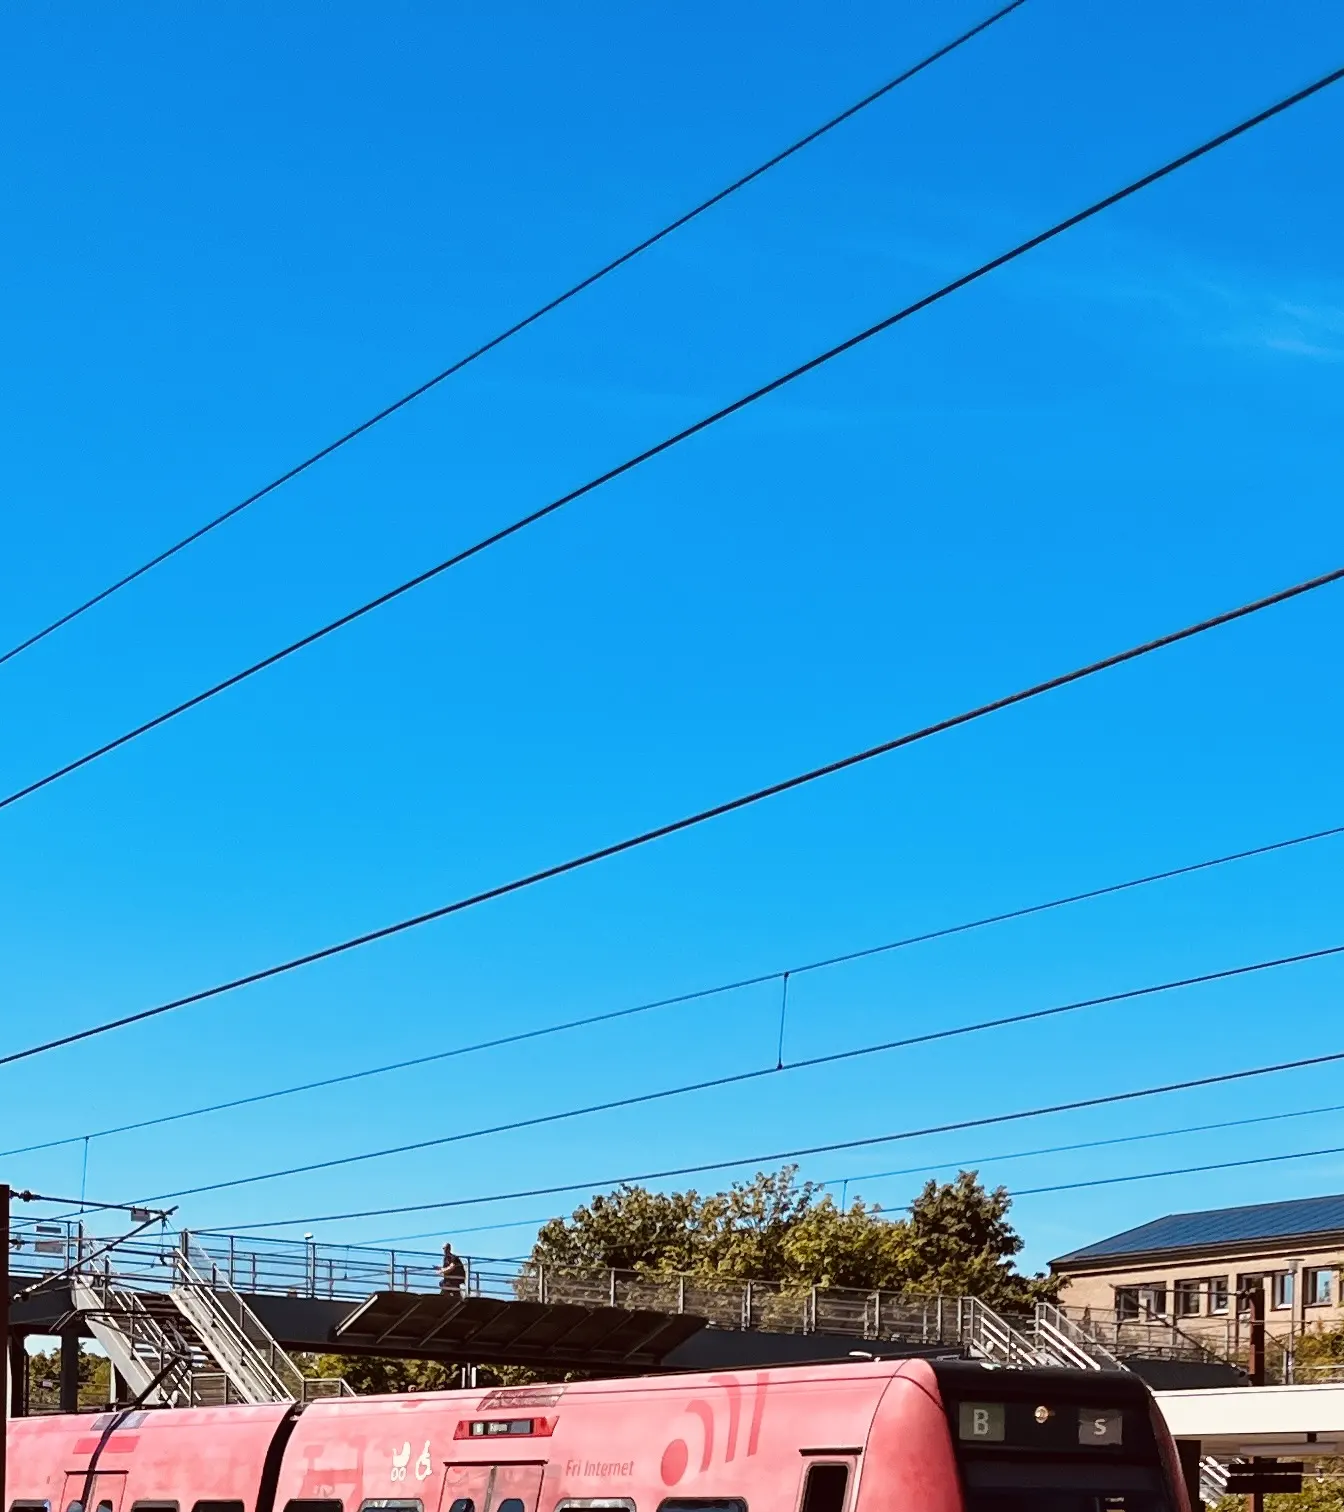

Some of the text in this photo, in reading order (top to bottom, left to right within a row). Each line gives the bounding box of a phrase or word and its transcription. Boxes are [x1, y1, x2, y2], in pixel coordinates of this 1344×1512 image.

[973, 1408, 989, 1435] B
[565, 1459, 634, 1476] Fri Internet
